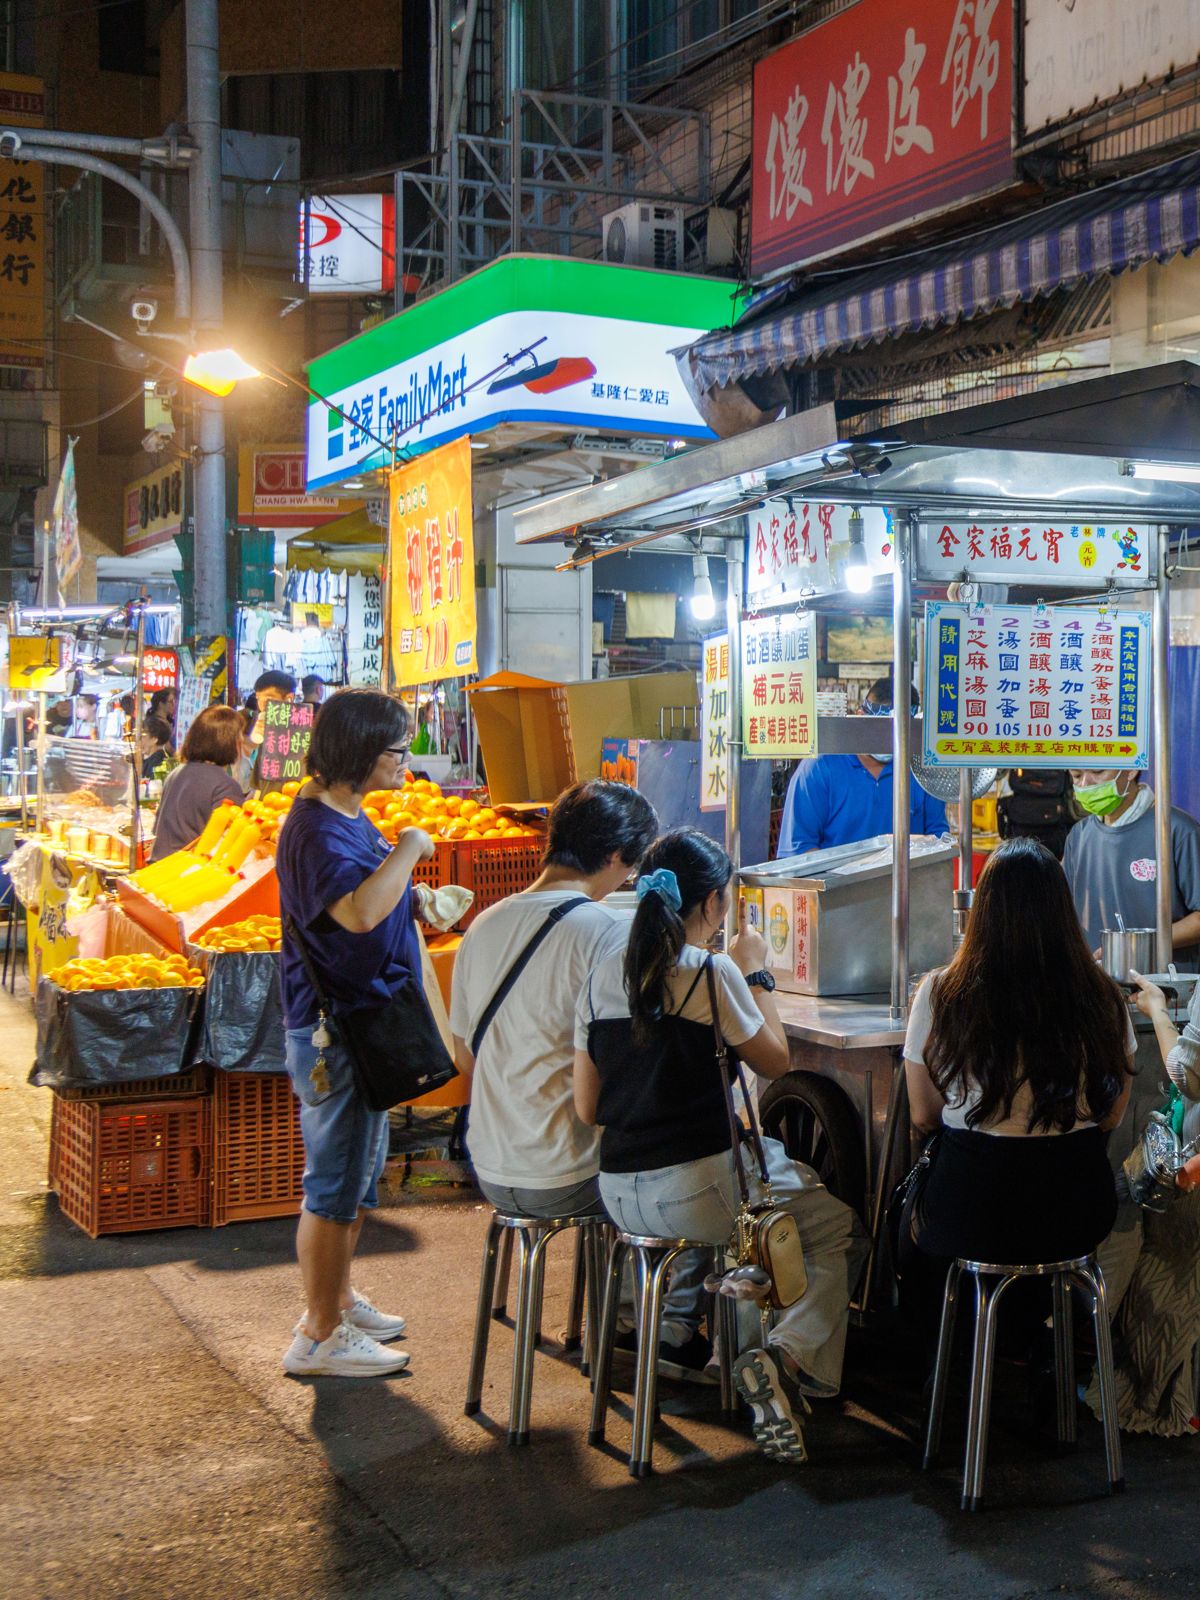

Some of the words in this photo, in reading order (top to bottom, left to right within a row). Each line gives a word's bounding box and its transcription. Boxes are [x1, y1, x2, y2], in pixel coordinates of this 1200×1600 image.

[1, 158, 36, 286] 化銀行
[348, 395, 374, 452] 全家
[379, 353, 468, 438] FamilyMart
[591, 382, 671, 406] 基隆仁愛店
[255, 496, 287, 505] CHANG
[290, 496, 309, 505] HWA
[754, 504, 836, 576] 全家福元宵
[1070, 526, 1106, 538] 老林牌
[937, 525, 1065, 564] 全家福元宵
[1083, 544, 1093, 567] 元宵
[407, 506, 463, 616] 柳橙汁
[1001, 617, 1019, 628] 2
[1032, 619, 1051, 629] 3
[1064, 620, 1082, 631] 4
[1095, 622, 1113, 632] 5
[746, 626, 809, 666] 甜酒釀加蛋
[940, 625, 957, 728] 請用代號
[964, 629, 989, 718] 芝麻湯圓
[996, 631, 1021, 719] 湯圓加蛋
[1029, 632, 1053, 719] 酒釀湯圓
[1059, 632, 1084, 720] 酒釀加蛋
[1090, 634, 1115, 721] 酒釀加蛋湯圓
[753, 671, 804, 706] 補元氣
[963, 722, 988, 735] 90
[995, 722, 1020, 736] 105
[1027, 723, 1052, 737] 110
[1059, 723, 1082, 737] 95
[1089, 724, 1113, 738] 125
[708, 688, 728, 799] 加冰水
[942, 741, 1116, 754] 元宵盒裝請至店內購買
[283, 760, 300, 777] 100
